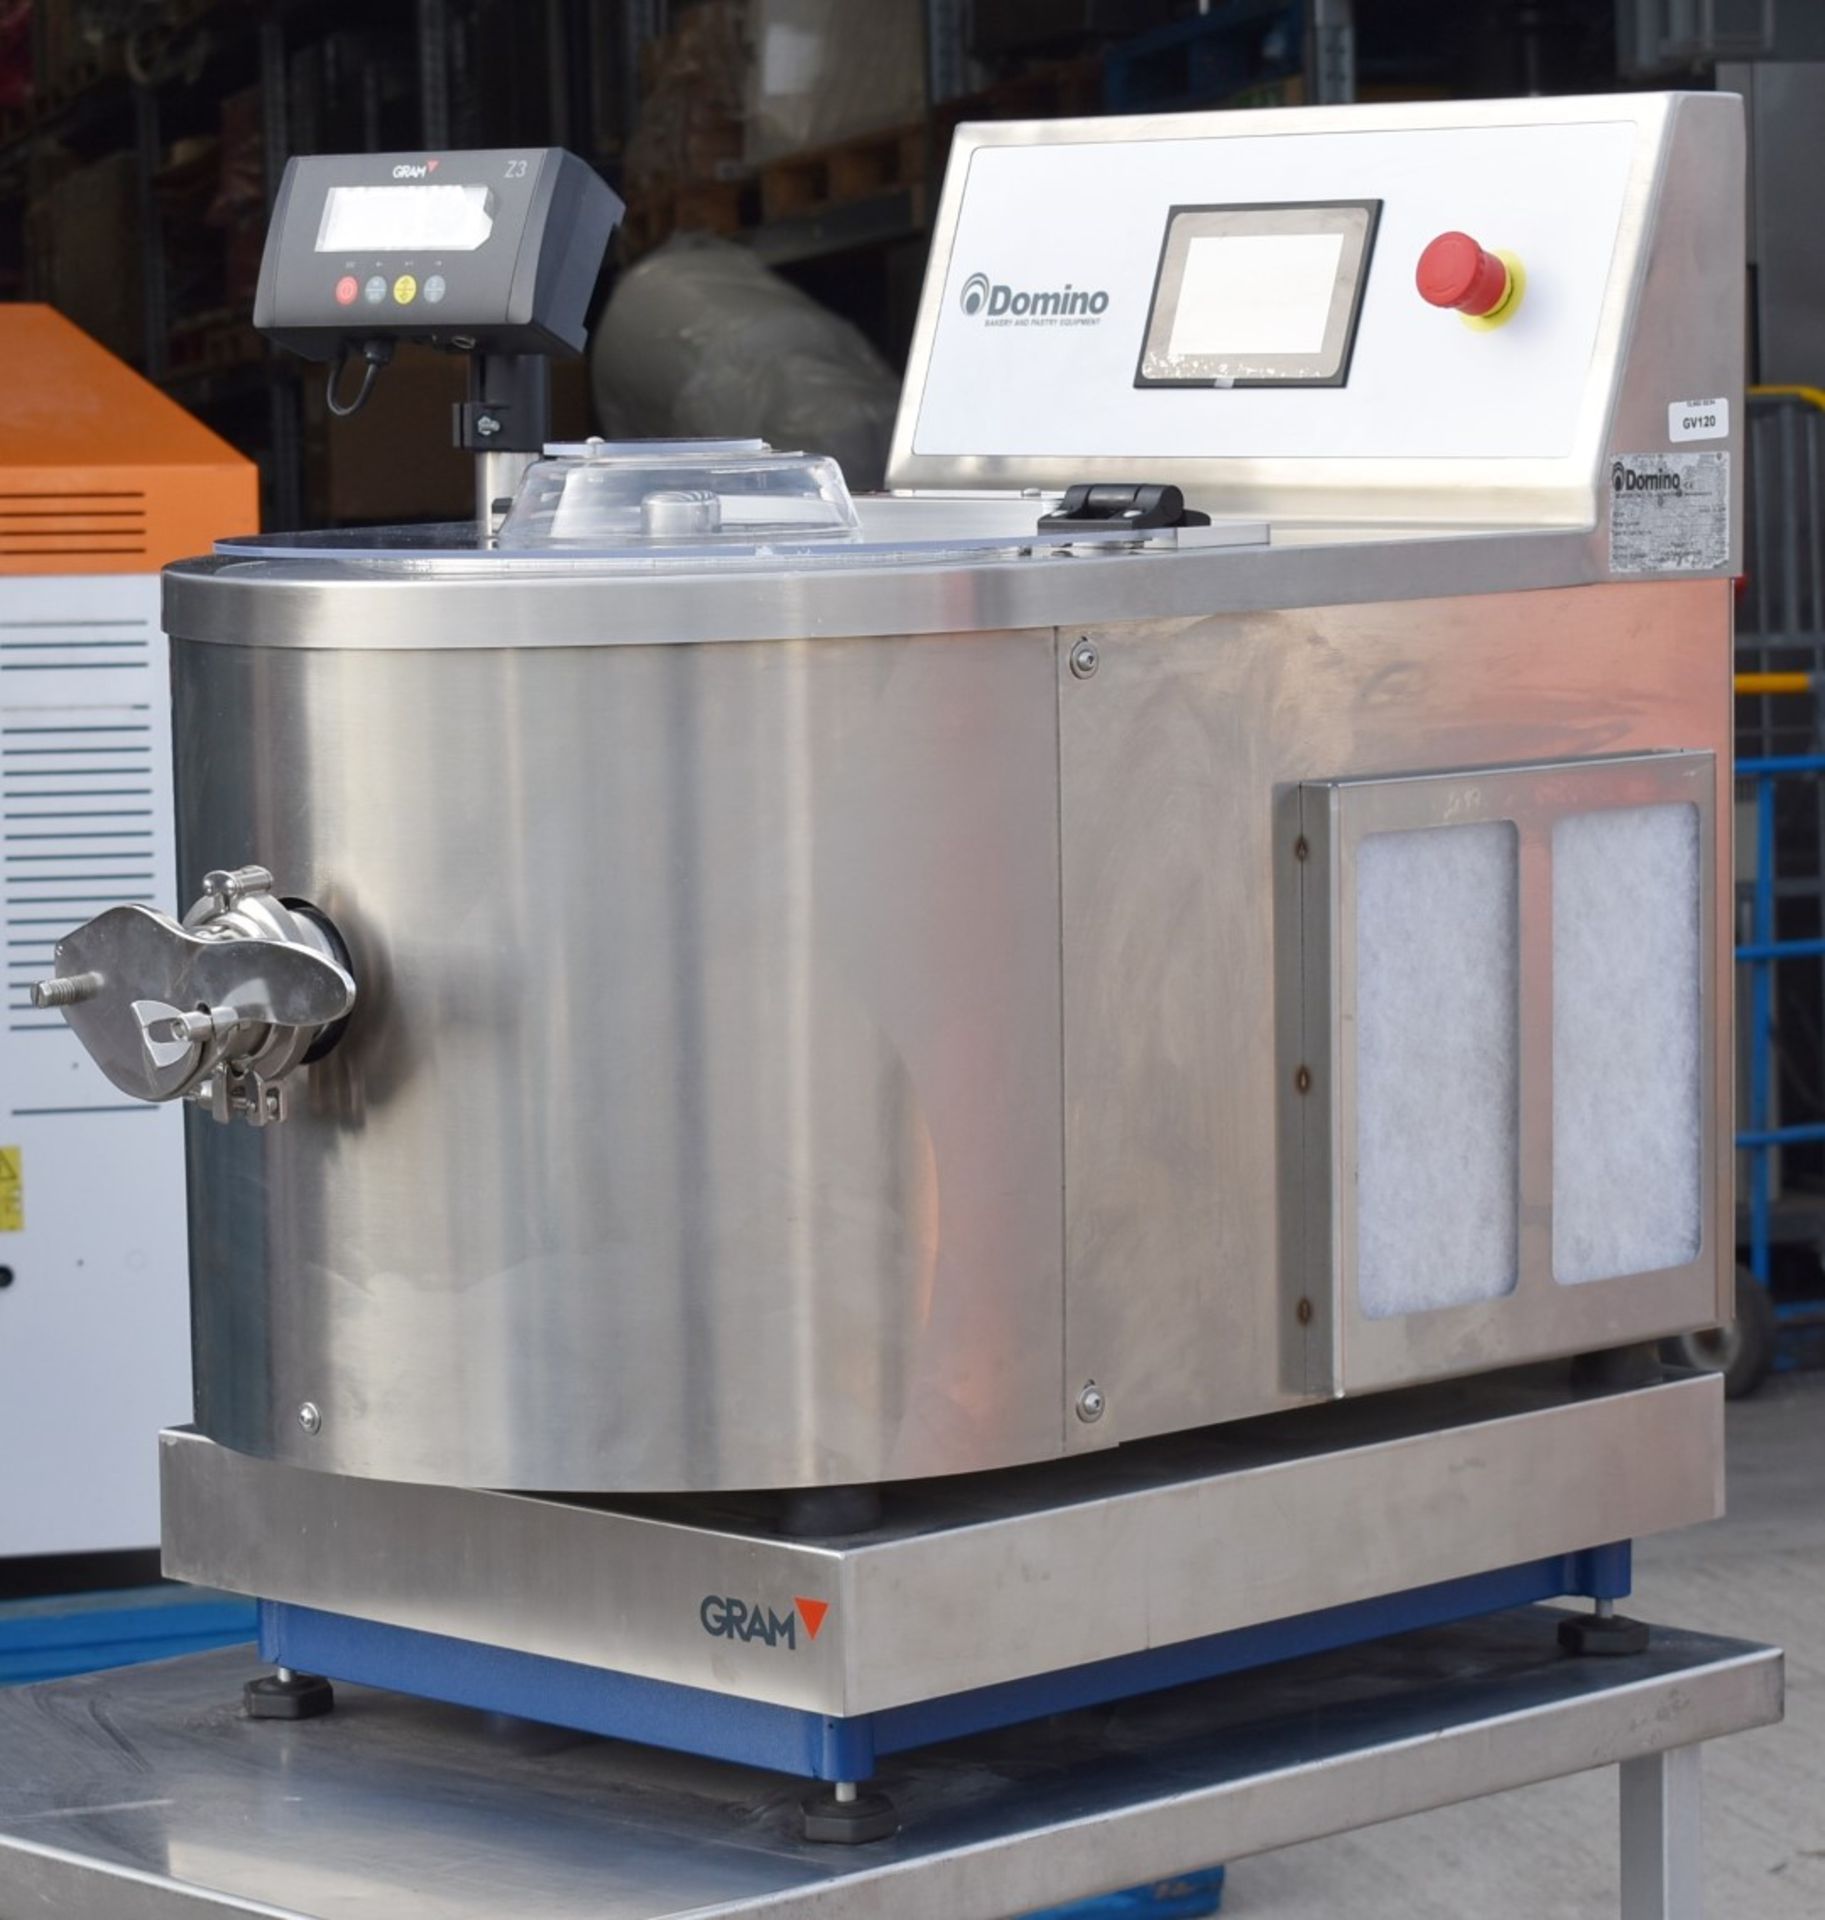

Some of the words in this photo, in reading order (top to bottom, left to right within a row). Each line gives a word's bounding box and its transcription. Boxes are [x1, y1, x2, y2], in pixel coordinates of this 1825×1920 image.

[392, 164, 427, 178] GRAM
[504, 160, 527, 178] Z3
[988, 284, 1109, 315] Domino
[1014, 319, 1030, 327] AND
[1682, 415, 1716, 430] GV120
[1626, 468, 1680, 490] Domino
[700, 1595, 796, 1650] GRAM
